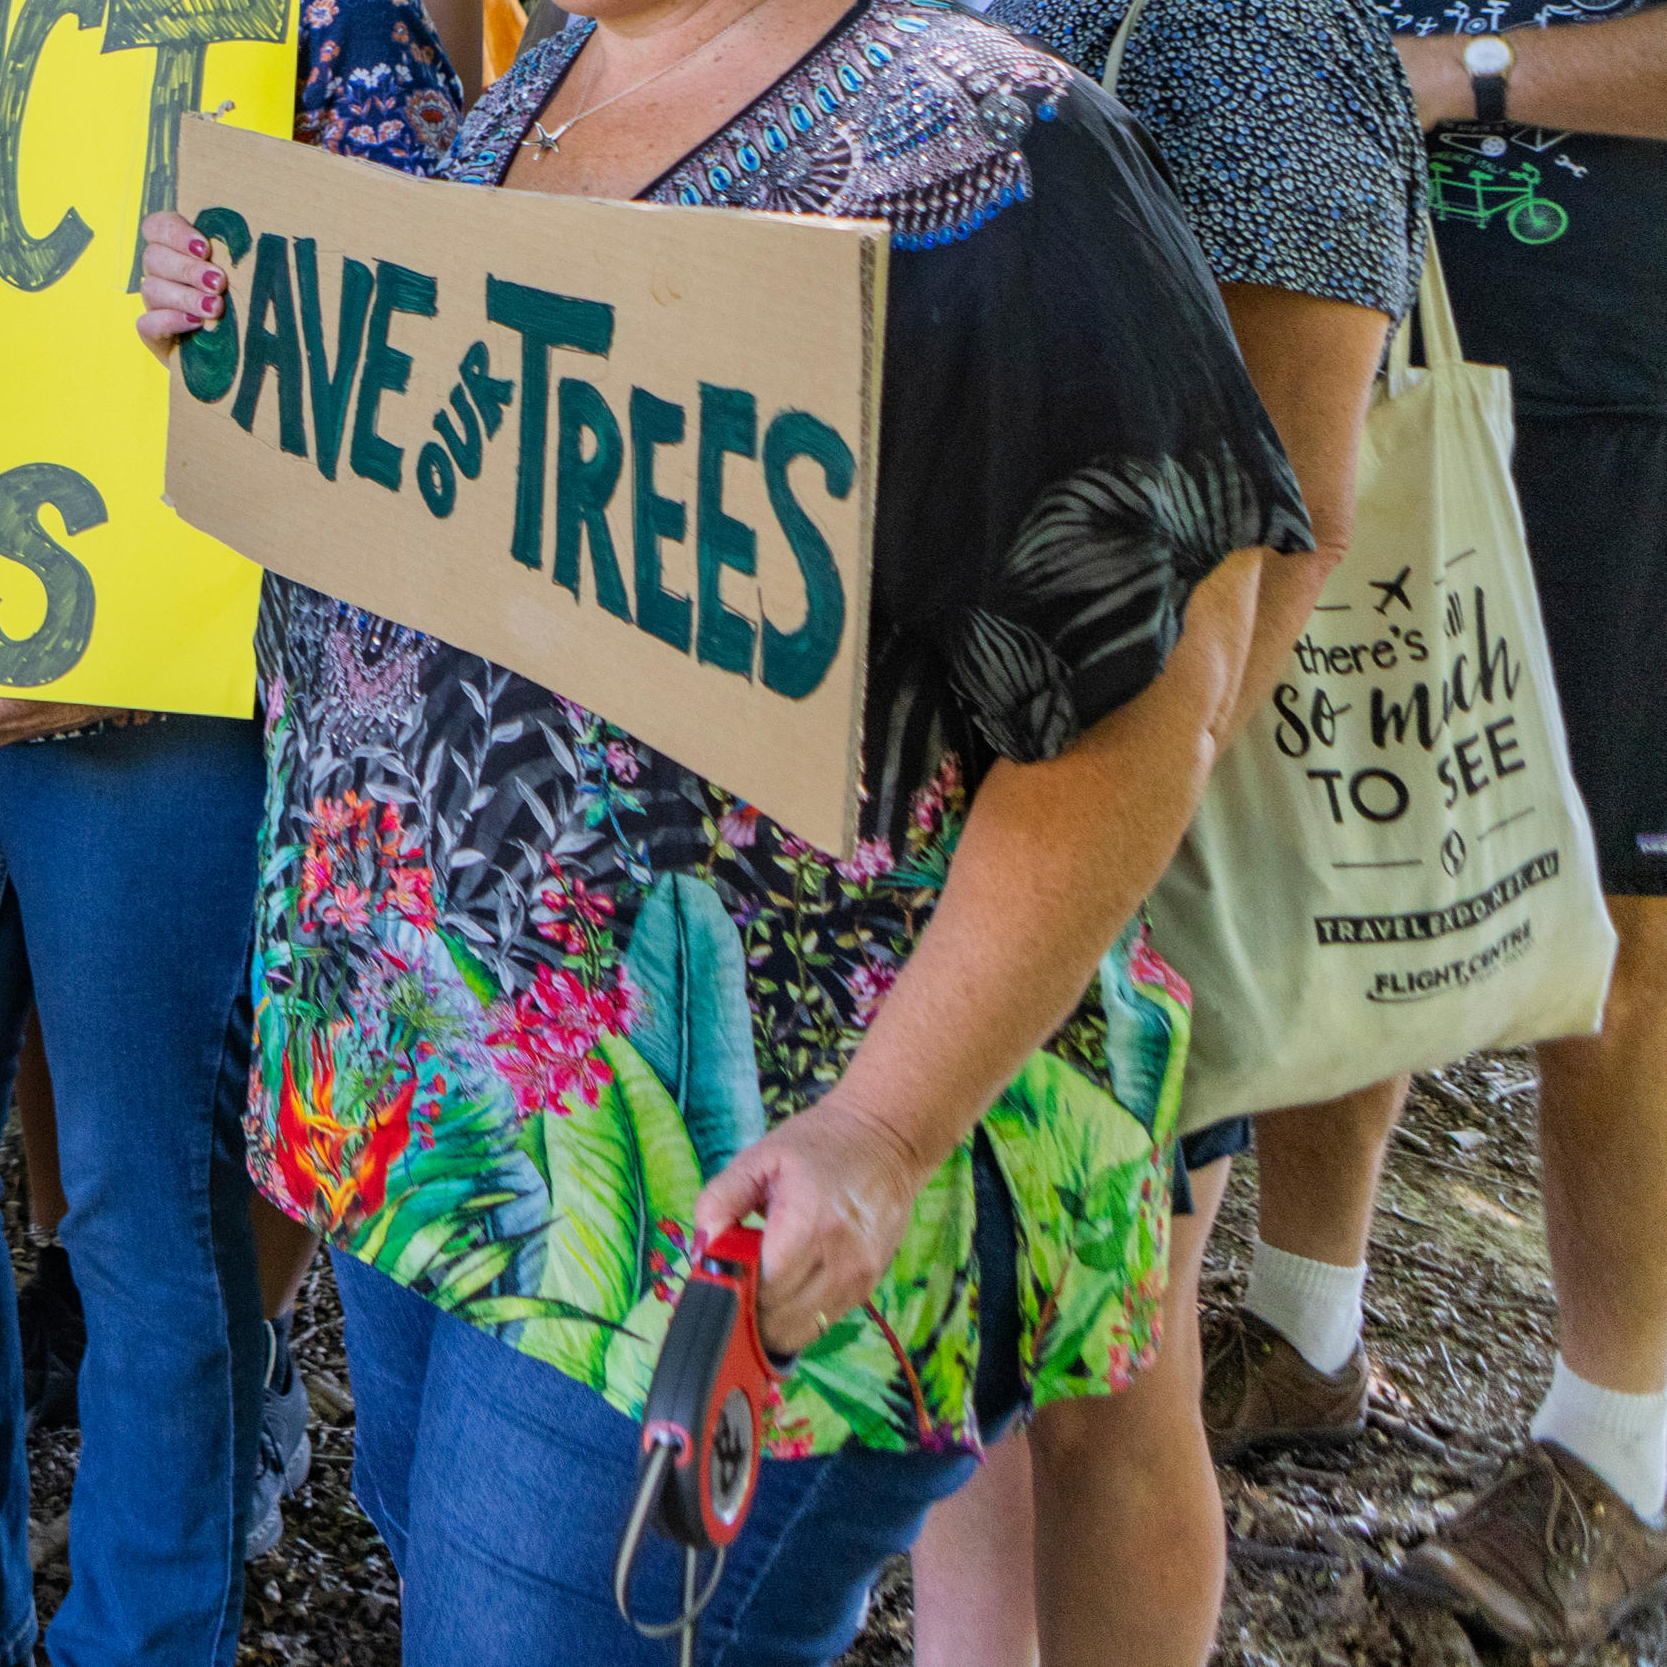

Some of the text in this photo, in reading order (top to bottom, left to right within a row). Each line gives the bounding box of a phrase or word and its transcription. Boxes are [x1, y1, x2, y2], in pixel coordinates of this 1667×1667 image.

[178, 206, 857, 700] SAVE OUR TREES
[1293, 624, 1429, 675] there's
[1306, 715, 1526, 824] TO SEE
[1375, 961, 1465, 994] FLIGHT
